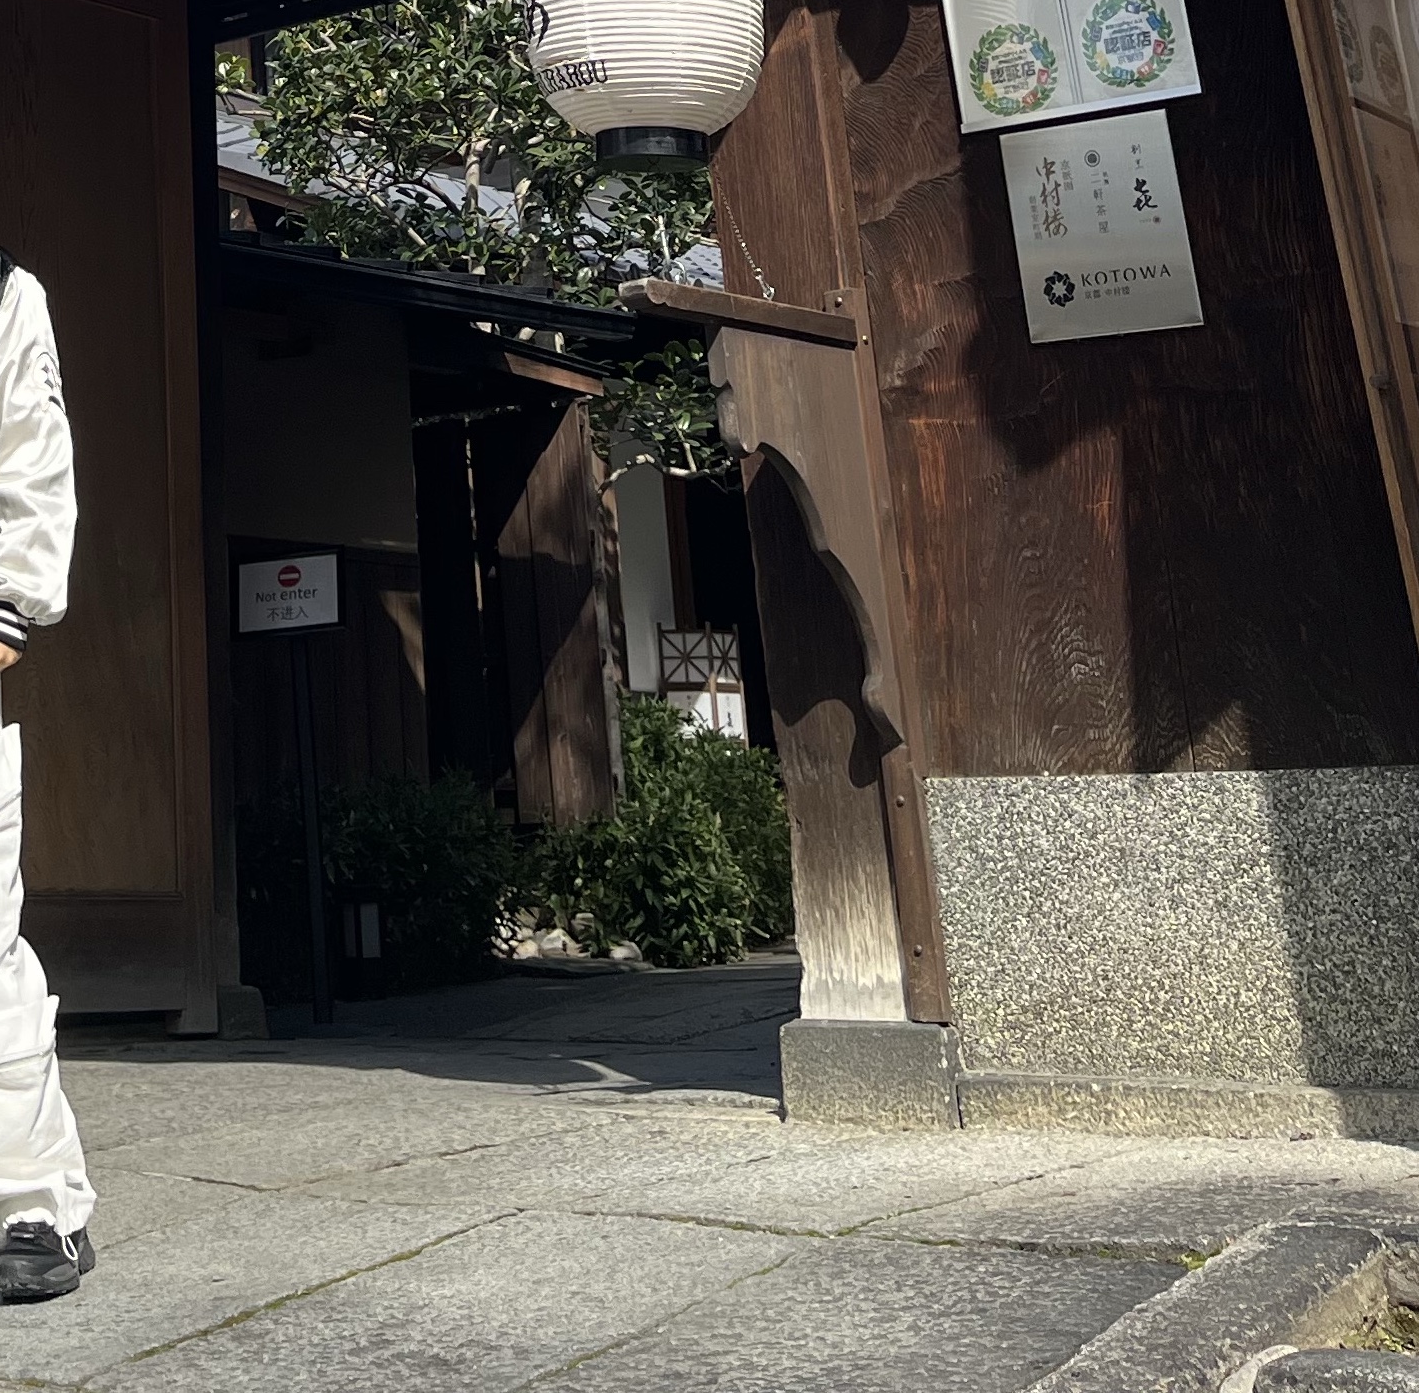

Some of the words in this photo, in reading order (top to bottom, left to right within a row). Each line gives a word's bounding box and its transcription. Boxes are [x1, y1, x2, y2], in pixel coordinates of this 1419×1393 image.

[1081, 263, 1171, 287] KOTOWA
[255, 591, 277, 603] Not
[280, 587, 319, 601] enter
